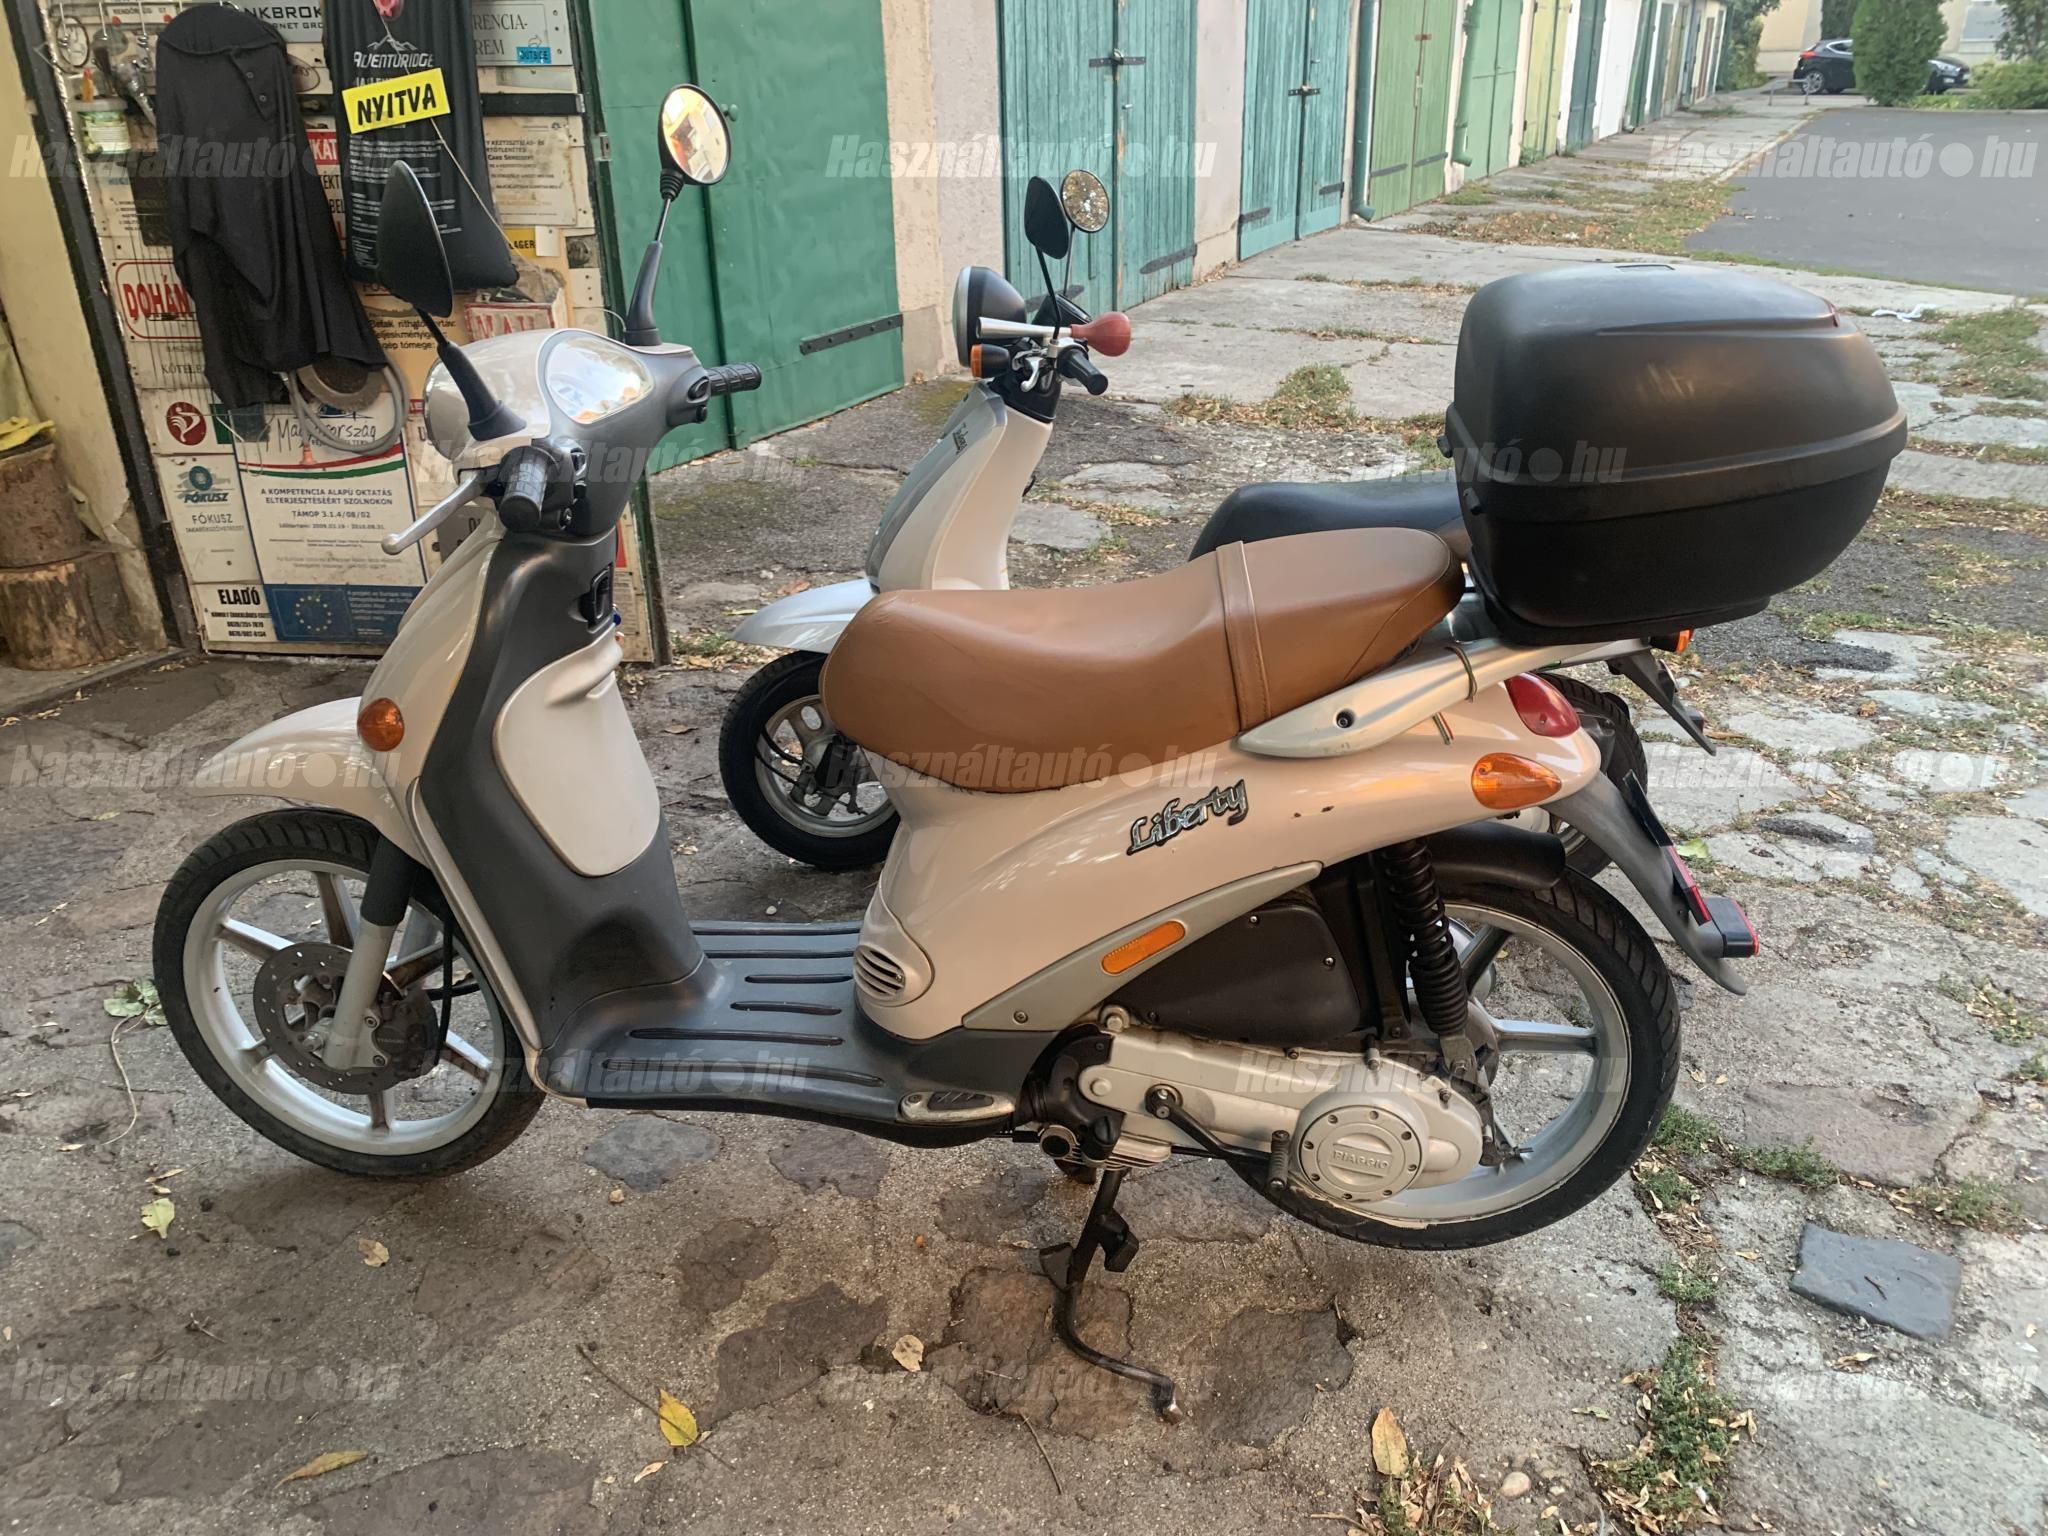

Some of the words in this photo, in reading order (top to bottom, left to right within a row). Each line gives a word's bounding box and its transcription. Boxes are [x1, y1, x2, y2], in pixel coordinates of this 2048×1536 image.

[357, 83, 437, 126] NYITVA
[184, 491, 229, 504] FÓKUSZ
[192, 512, 233, 525] FÓKUSZ
[1127, 779, 1248, 856] Liberty
